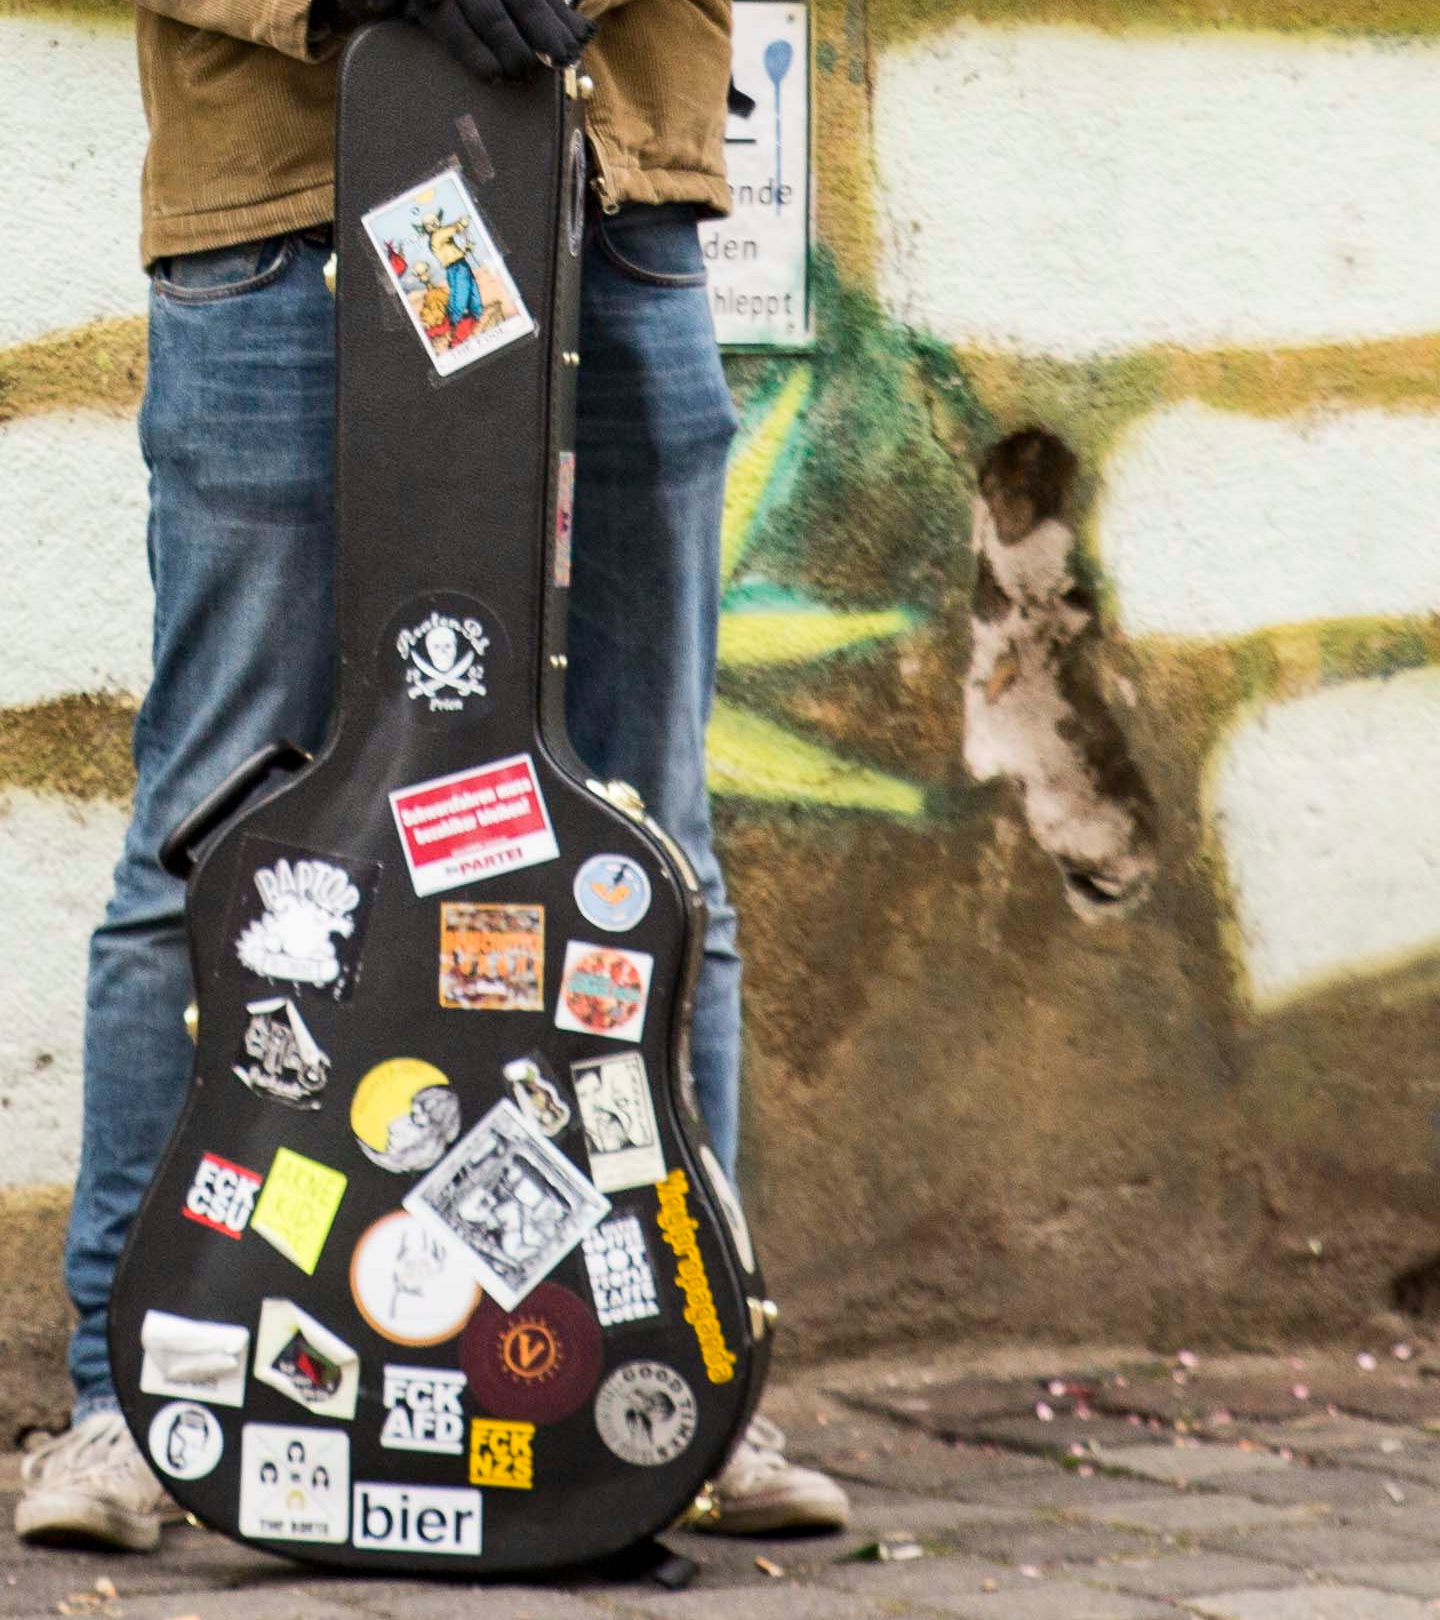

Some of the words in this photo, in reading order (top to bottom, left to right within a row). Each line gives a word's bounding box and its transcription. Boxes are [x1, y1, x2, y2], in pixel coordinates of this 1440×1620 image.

[728, 178, 793, 206] nde
[459, 846, 524, 876] PARTEI
[194, 1158, 262, 1211] FCK
[185, 1185, 252, 1233] CSU
[383, 1379, 465, 1416] FCK
[381, 1405, 465, 1443] AFD
[471, 1430, 534, 1458] FCK
[470, 1451, 534, 1482] NZS
[362, 1492, 474, 1545] bier
